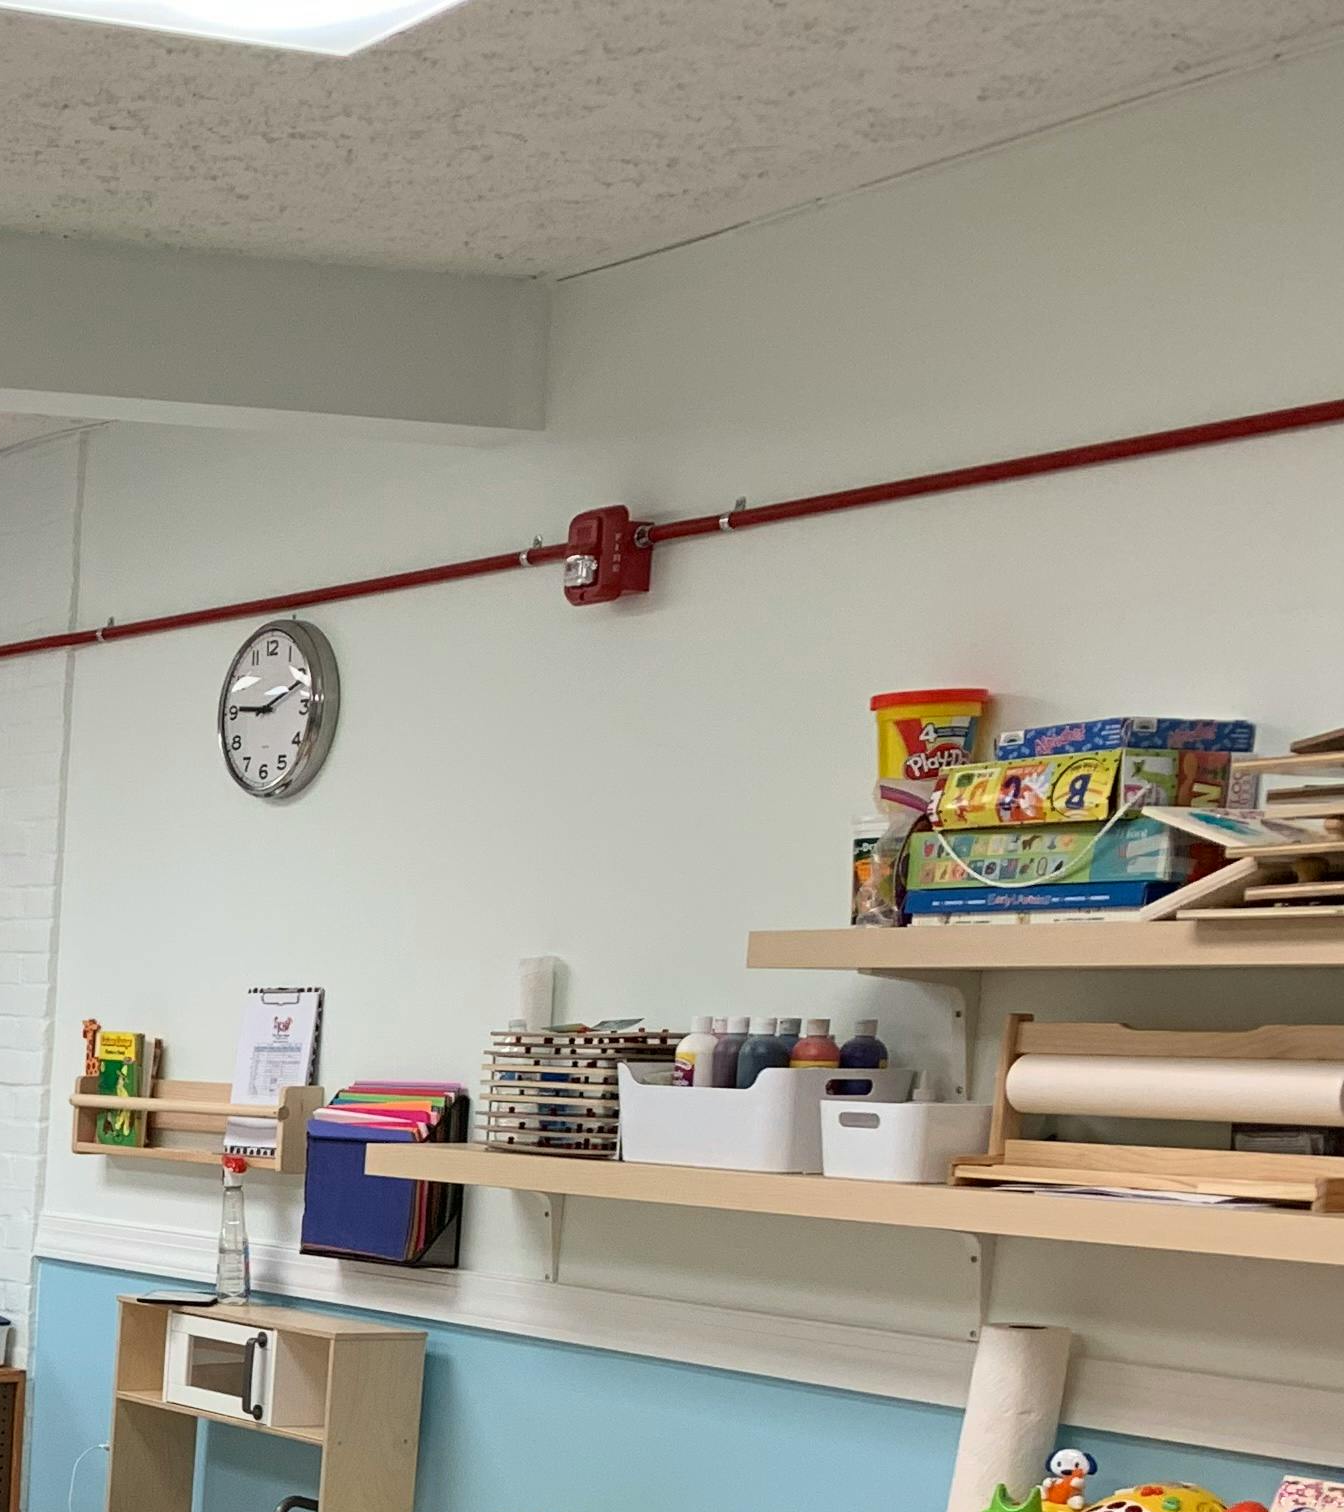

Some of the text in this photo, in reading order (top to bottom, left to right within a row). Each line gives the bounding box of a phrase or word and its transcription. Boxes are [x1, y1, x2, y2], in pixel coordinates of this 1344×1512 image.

[612, 533, 622, 572] FIRE
[266, 640, 279, 656] 12
[251, 650, 259, 666] 11
[229, 705, 238, 720] 9
[299, 699, 309, 715] 3
[292, 732, 301, 747] 4
[919, 723, 937, 742] 4
[231, 735, 242, 750] 8
[243, 757, 252, 772] 7
[276, 755, 287, 771] 5
[258, 764, 268, 780] 6
